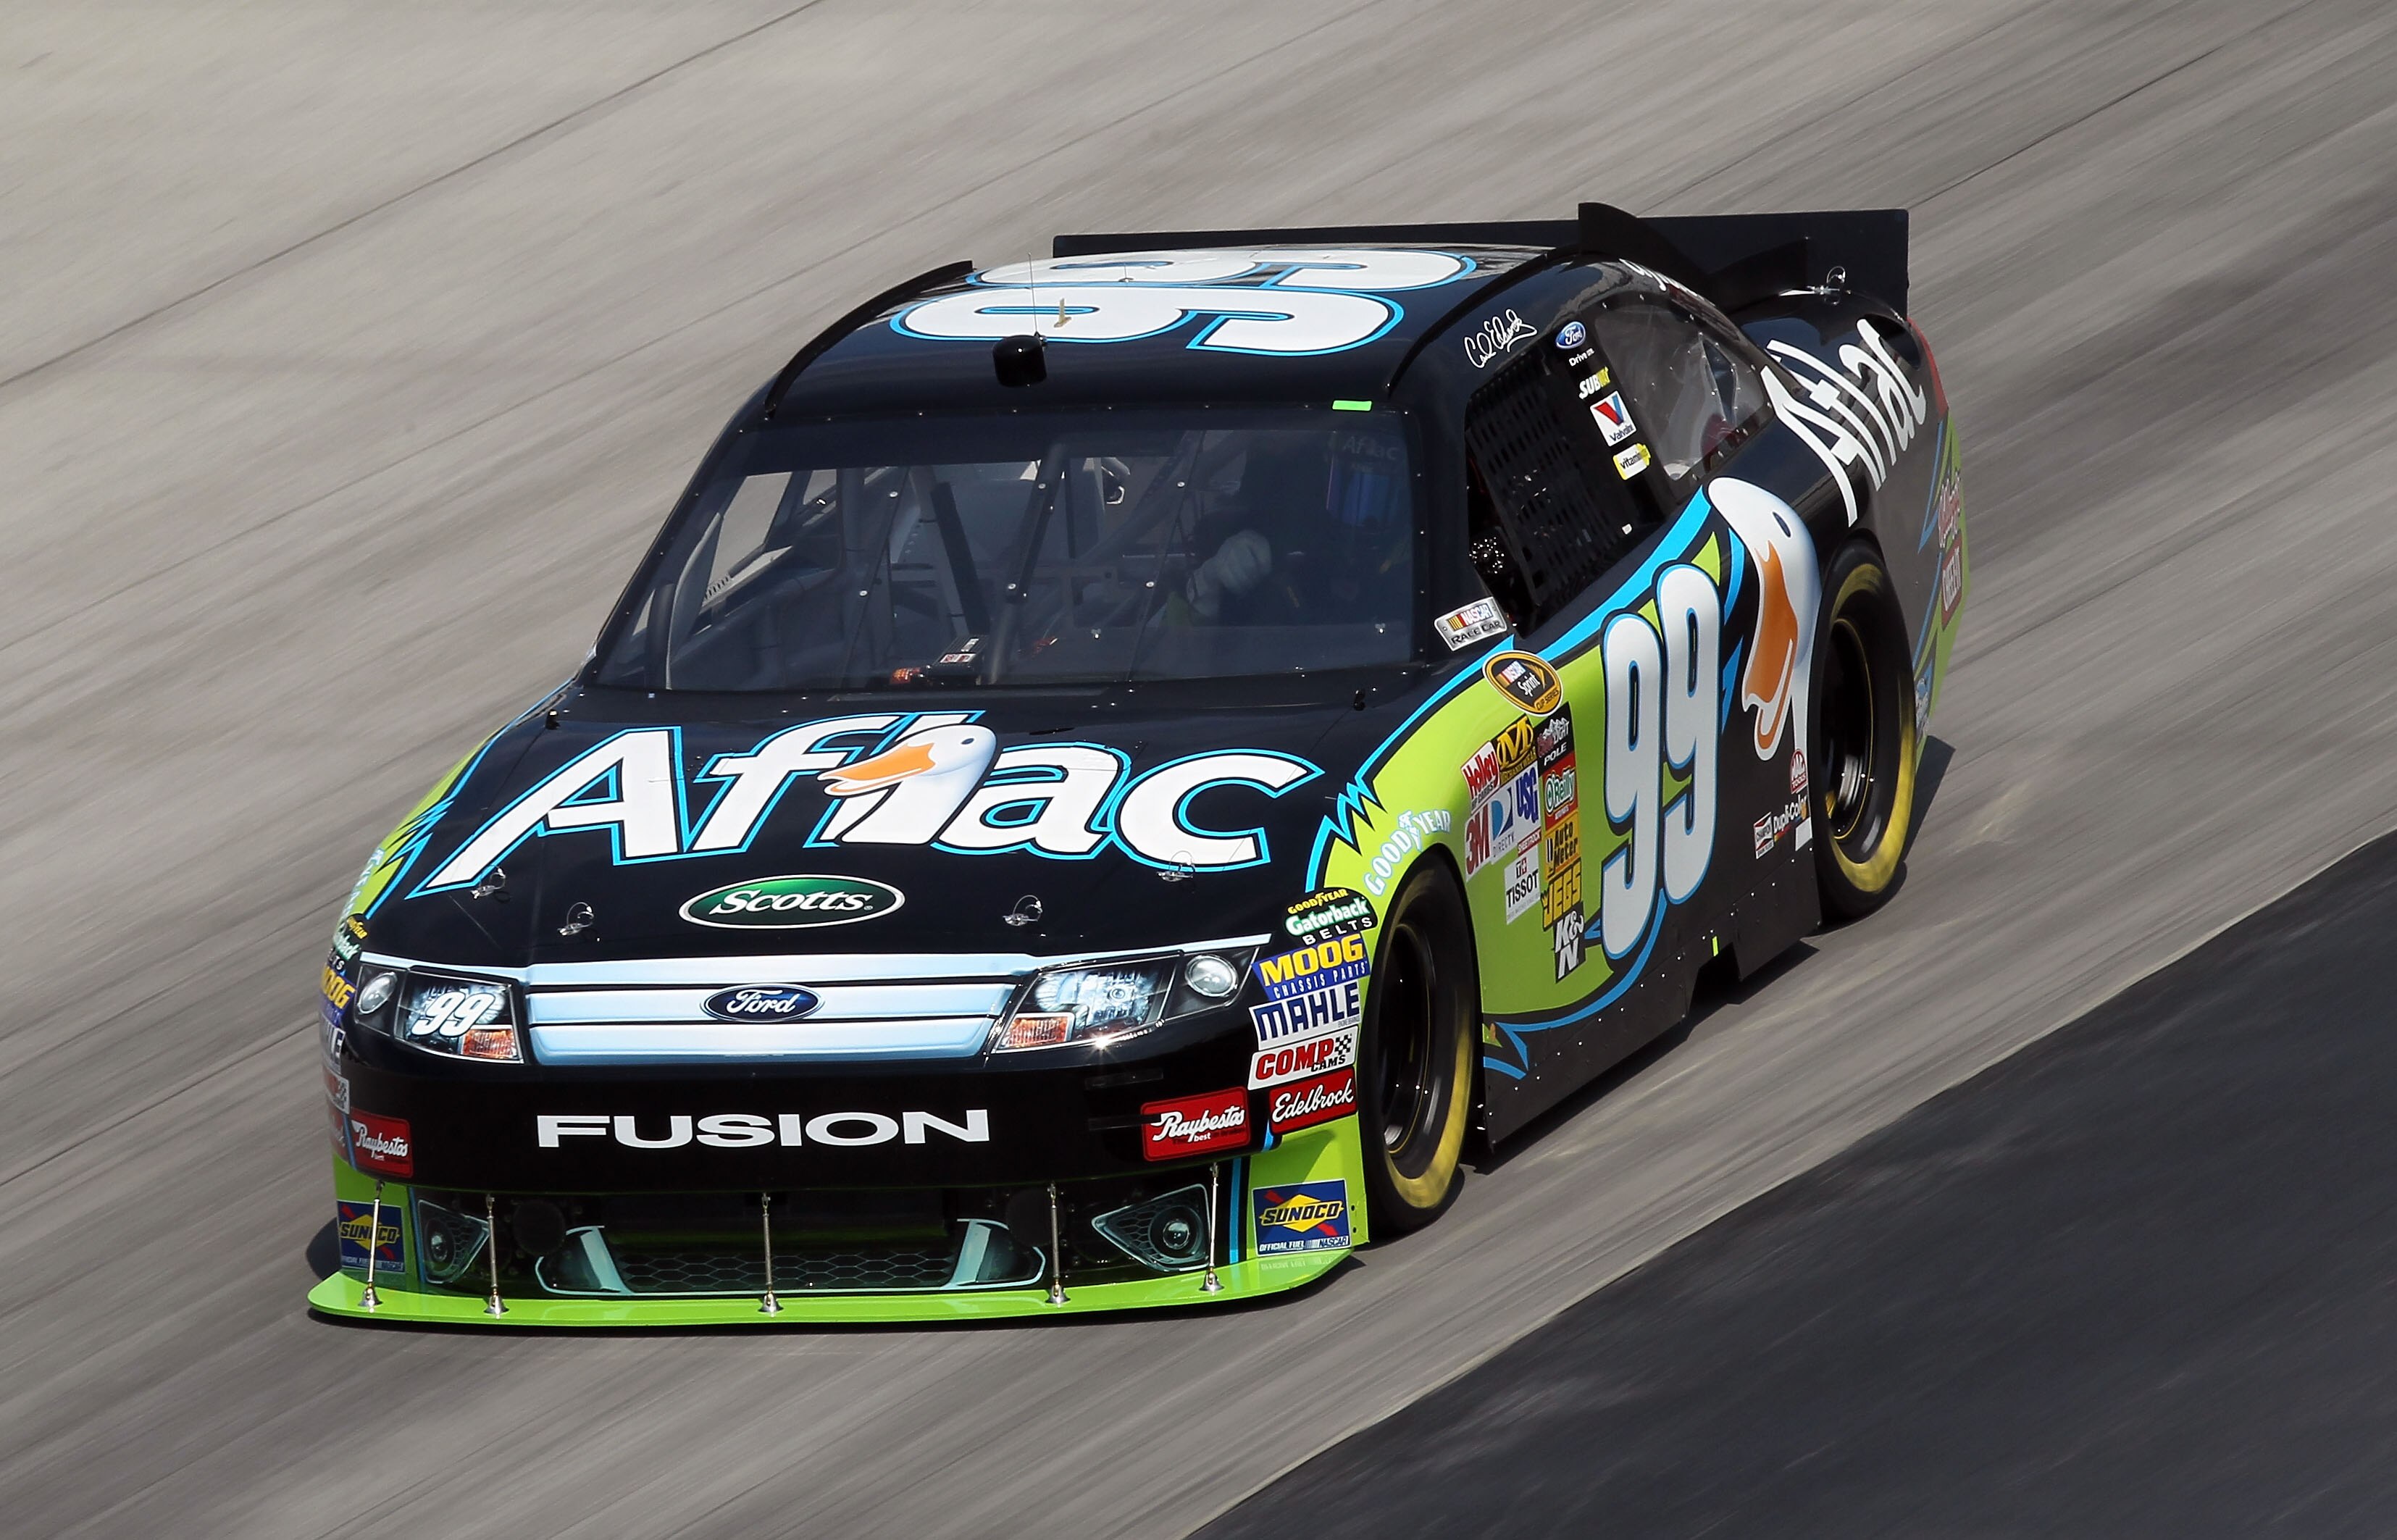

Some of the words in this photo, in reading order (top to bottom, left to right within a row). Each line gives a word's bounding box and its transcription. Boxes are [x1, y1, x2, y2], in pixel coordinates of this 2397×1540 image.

[1565, 325, 1583, 346] Ford
[1760, 319, 1927, 527] Aflac
[1451, 628, 1481, 645] RACE
[1481, 621, 1502, 632] CAR
[1460, 603, 1493, 627] NASCAR
[1518, 672, 1541, 697] Sprint
[1544, 742, 1568, 766] POLE
[1602, 564, 1720, 958] 99
[1463, 751, 1499, 800] Holley
[1545, 770, 1576, 813] O'Reilly
[408, 711, 1322, 897] Aflac
[1516, 767, 1538, 824] USG
[1774, 795, 1807, 833] Dupli-Color
[1363, 809, 1451, 896] GOODYEAR
[1466, 803, 1491, 874] 3M
[1554, 837, 1578, 868] Meter
[1555, 821, 1573, 849] Auto
[708, 890, 873, 915] Scotts
[1287, 888, 1350, 915] GOODYEAR
[1506, 869, 1539, 908] TISSOT
[1541, 861, 1582, 932] JEGS
[1285, 897, 1371, 936] Gatorback
[1302, 917, 1373, 945] BELTS
[1260, 934, 1363, 986] MOOG
[1273, 974, 1326, 999] CHASSIS
[1333, 961, 1366, 982] PARTS
[411, 992, 496, 1037] 99
[726, 989, 800, 1013] Ford
[1253, 982, 1360, 1041] MAHLE
[1256, 1039, 1334, 1080] COMP
[1311, 1055, 1347, 1071] CAMS
[1273, 1079, 1353, 1122] Edelbrock
[351, 1120, 409, 1158] Raybestos
[537, 1109, 990, 1148] FUSION
[1150, 1105, 1245, 1142] Raybestos
[1194, 1132, 1211, 1142] best
[340, 1223, 398, 1242] SUNCO
[1263, 1202, 1340, 1225] SUNOCO
[1259, 1242, 1288, 1252] OFFICIAL
[1289, 1240, 1305, 1250] FUEL
[1319, 1236, 1347, 1248] NASCAR
